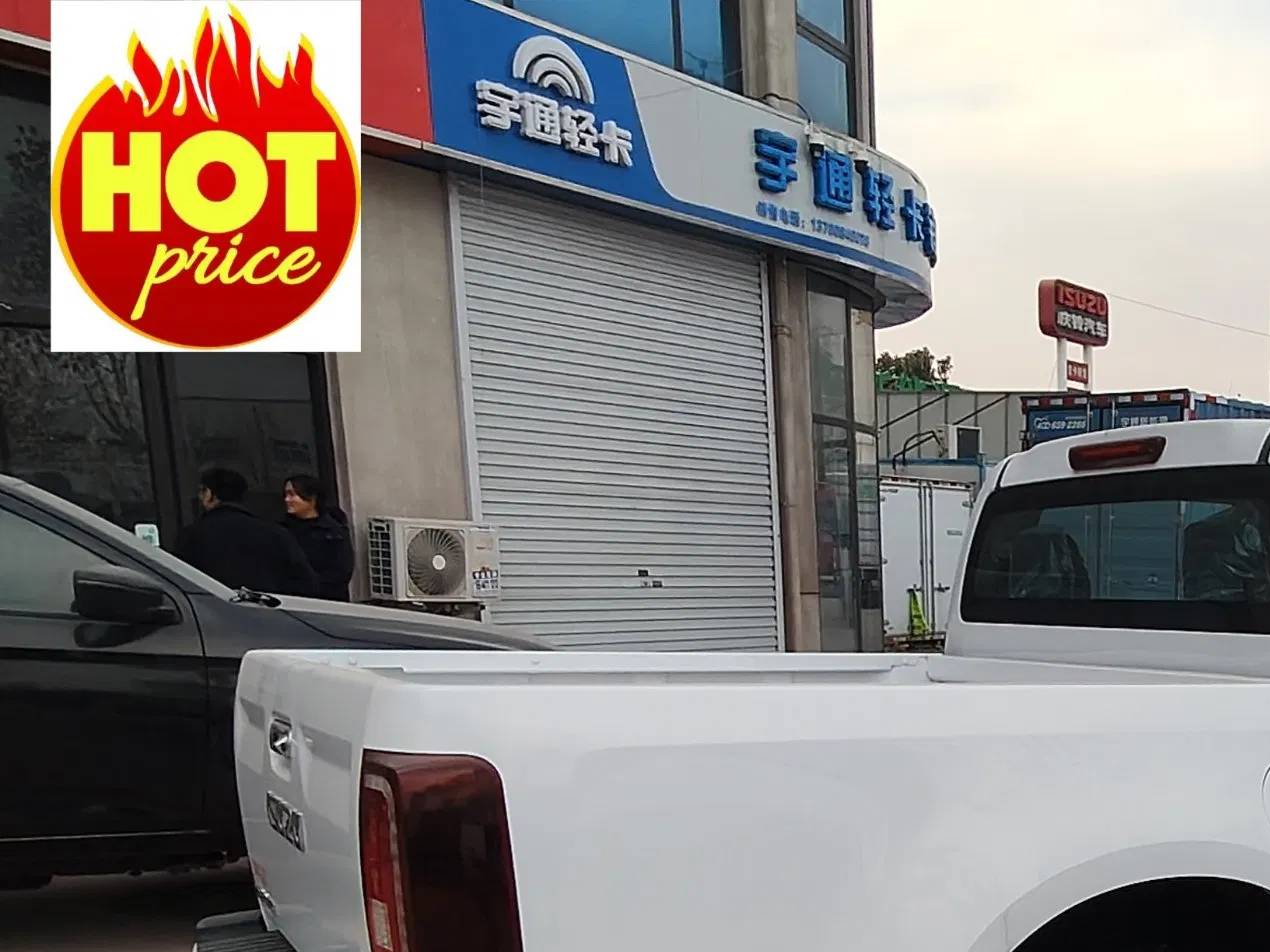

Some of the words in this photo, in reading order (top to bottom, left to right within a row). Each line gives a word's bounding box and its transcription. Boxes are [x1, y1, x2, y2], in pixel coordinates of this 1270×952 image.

[476, 79, 634, 167] 宇通轻卡
[1058, 283, 1107, 316] ISUZU
